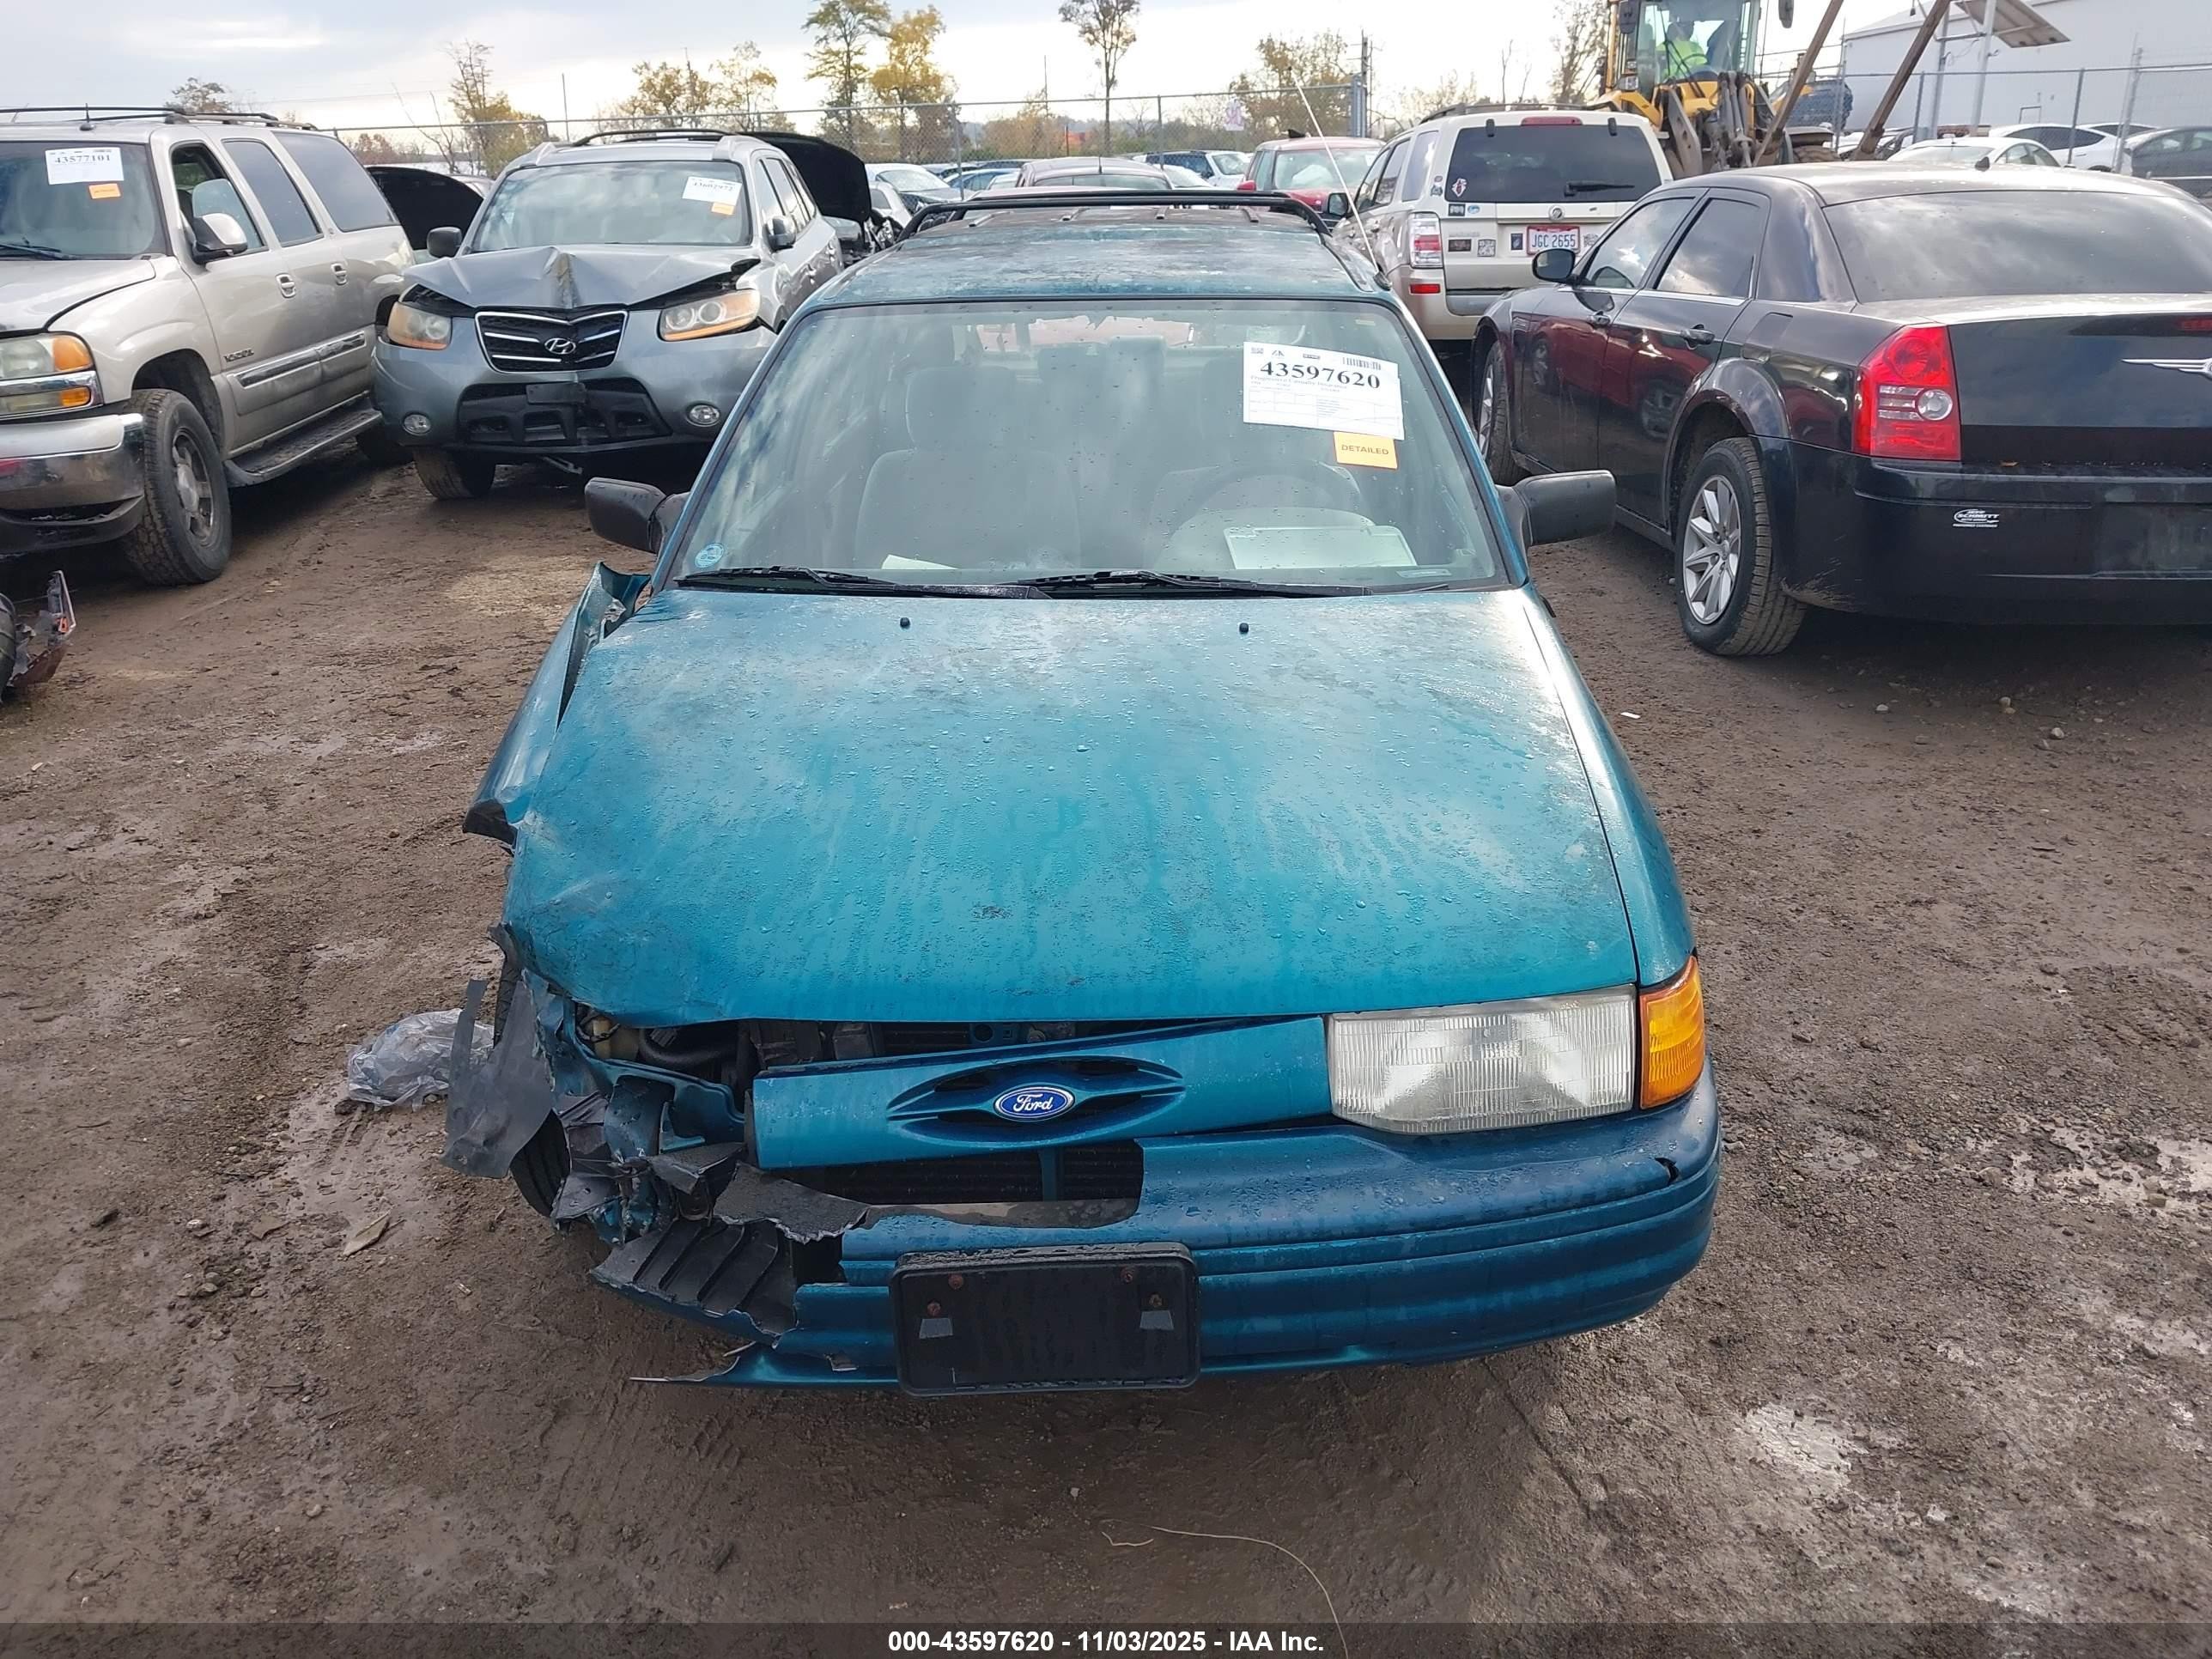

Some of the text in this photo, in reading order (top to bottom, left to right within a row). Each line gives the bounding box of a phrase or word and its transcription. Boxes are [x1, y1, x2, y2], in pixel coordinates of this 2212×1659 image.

[55, 155, 110, 163] 43577101
[1532, 234, 1576, 247] JGC 2655
[1260, 362, 1381, 389] 43597620
[1341, 444, 1389, 455] DETAILED
[1013, 1093, 1054, 1112] Ford
